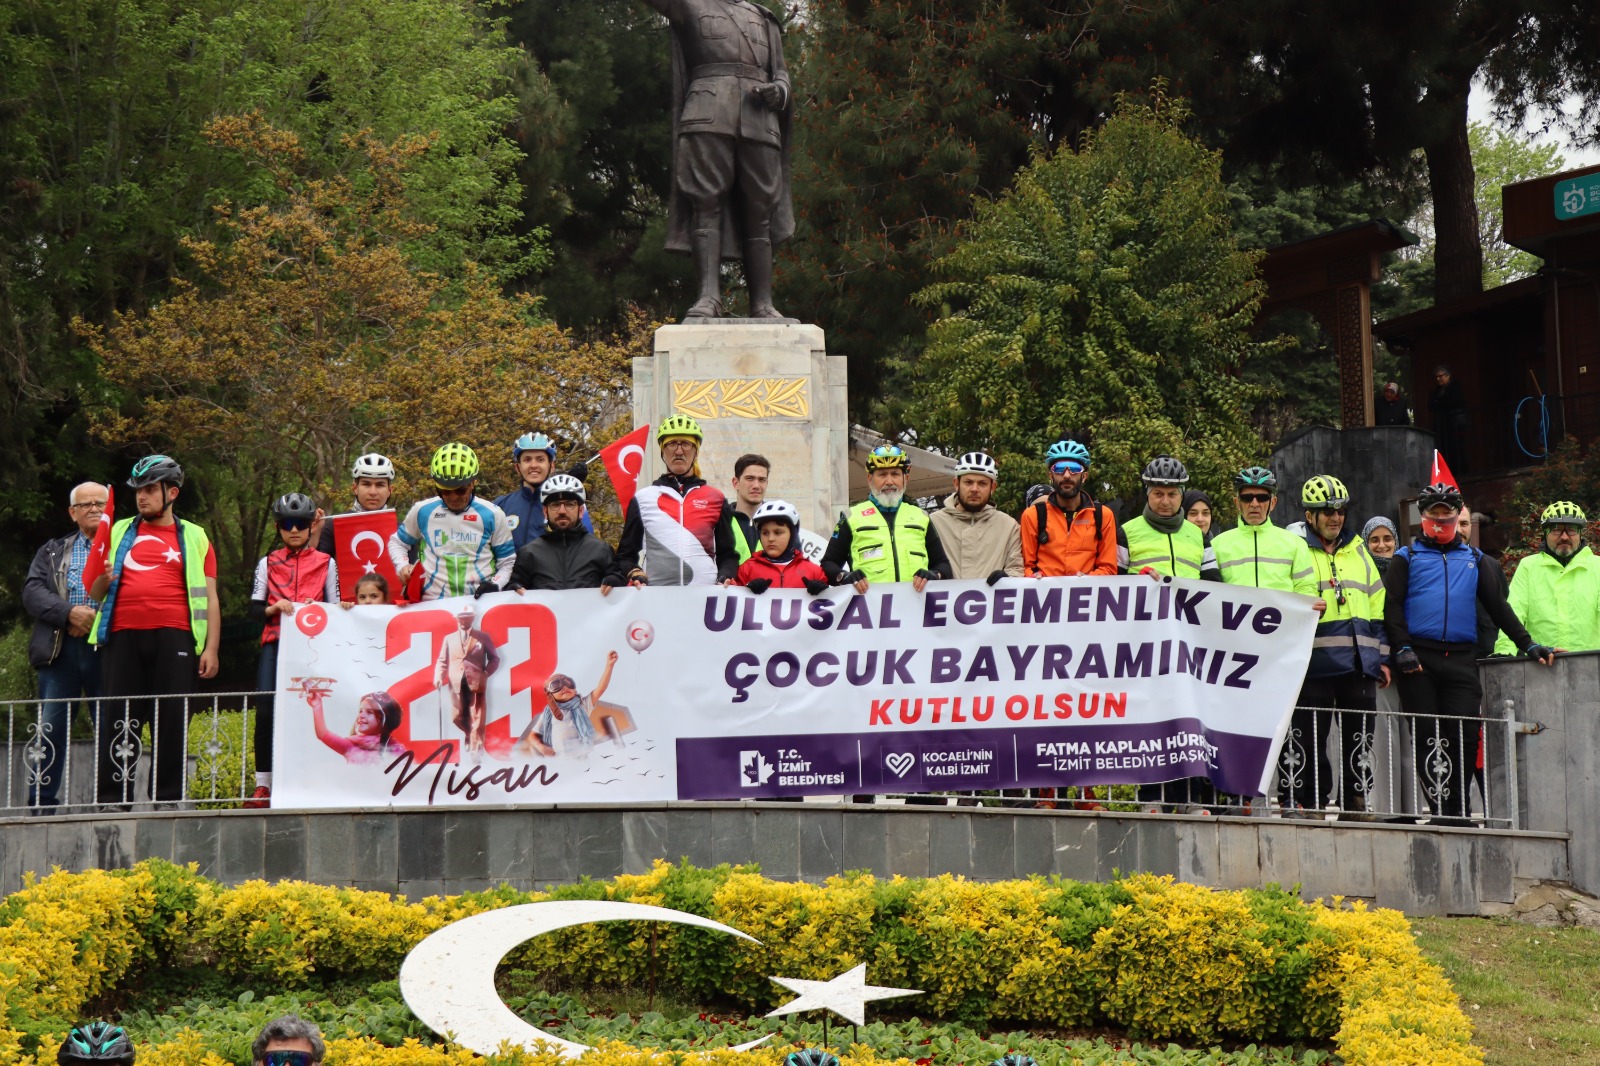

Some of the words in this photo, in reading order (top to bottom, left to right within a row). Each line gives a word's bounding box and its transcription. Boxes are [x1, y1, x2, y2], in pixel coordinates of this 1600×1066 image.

[703, 593, 902, 632] ULUSAL
[922, 576, 1211, 628] EGEMENLİK
[1221, 600, 1283, 635] ve
[385, 603, 559, 764] 23
[724, 648, 919, 703] ÇOCUK
[930, 639, 1260, 690] BAYRAMIMIZ
[868, 695, 995, 726] KUTLU
[1004, 692, 1128, 721] OLSUN
[777, 749, 802, 759] T.C.
[1036, 741, 1091, 756] FATMA
[1095, 738, 1162, 754] KAPLAN
[1166, 731, 1218, 758] HÜRRET
[384, 742, 559, 805] Nisan
[778, 759, 812, 773] İZMİT
[926, 763, 958, 776] KALBİ
[960, 762, 991, 775] İZMİT
[1096, 753, 1166, 770] BELEDİYE
[778, 771, 845, 786] BELEDİYESİ
